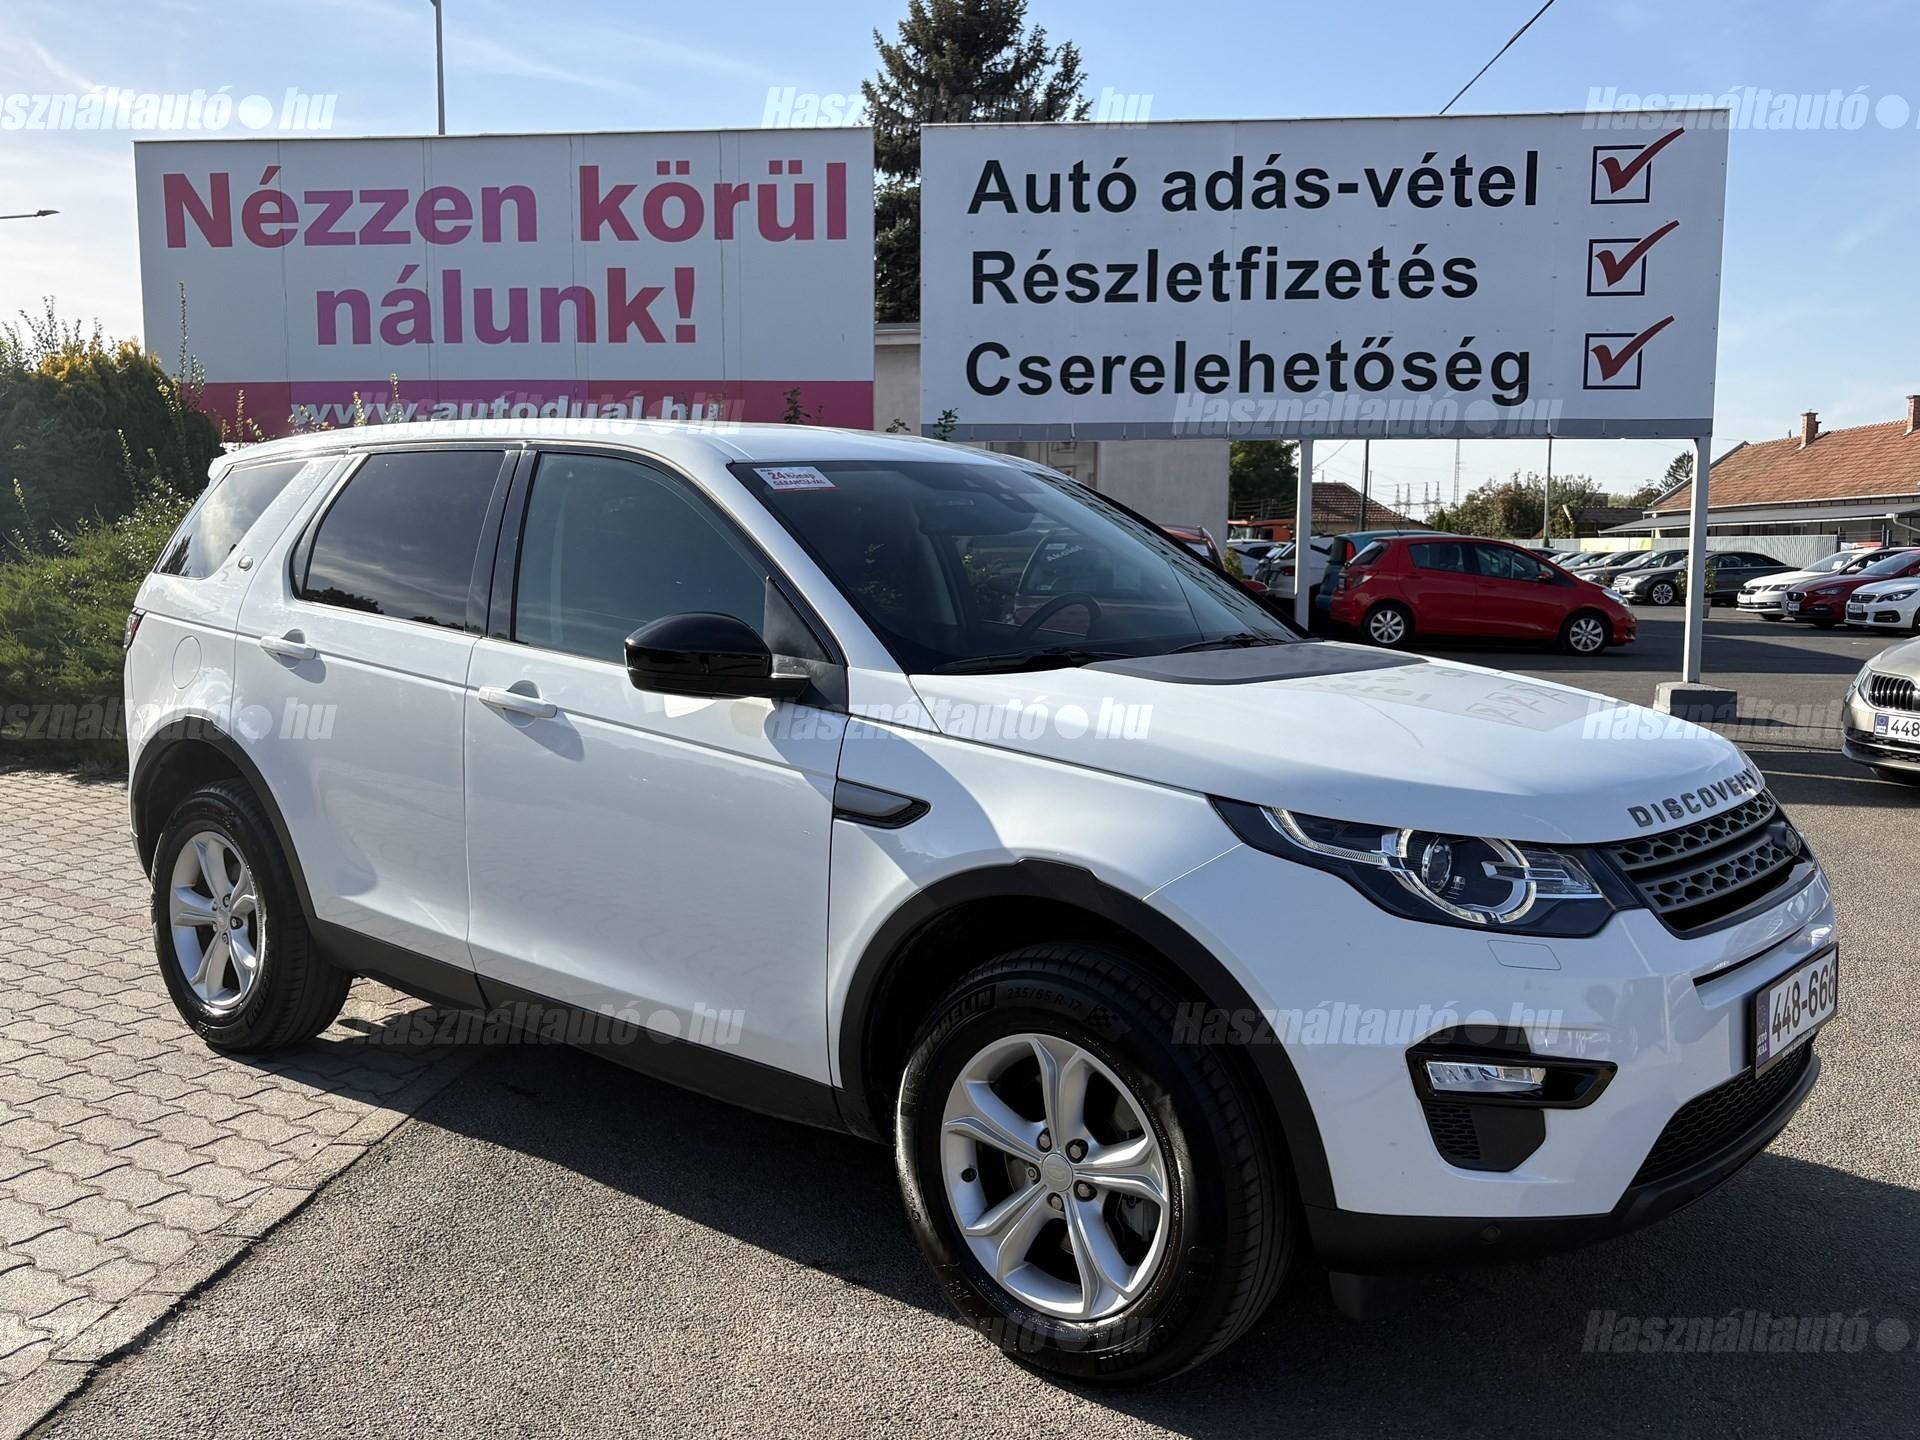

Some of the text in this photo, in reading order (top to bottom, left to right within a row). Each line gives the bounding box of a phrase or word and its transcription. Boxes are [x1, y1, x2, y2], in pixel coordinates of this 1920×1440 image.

[163, 160, 848, 248] Nézzen körül
[967, 150, 1538, 214] Autó adás-vétel
[316, 264, 696, 345] nálunk!
[972, 243, 1478, 304] Részletfizetés
[966, 335, 1530, 406] Cserelehetőség
[1627, 767, 1758, 827] DISCOVERY
